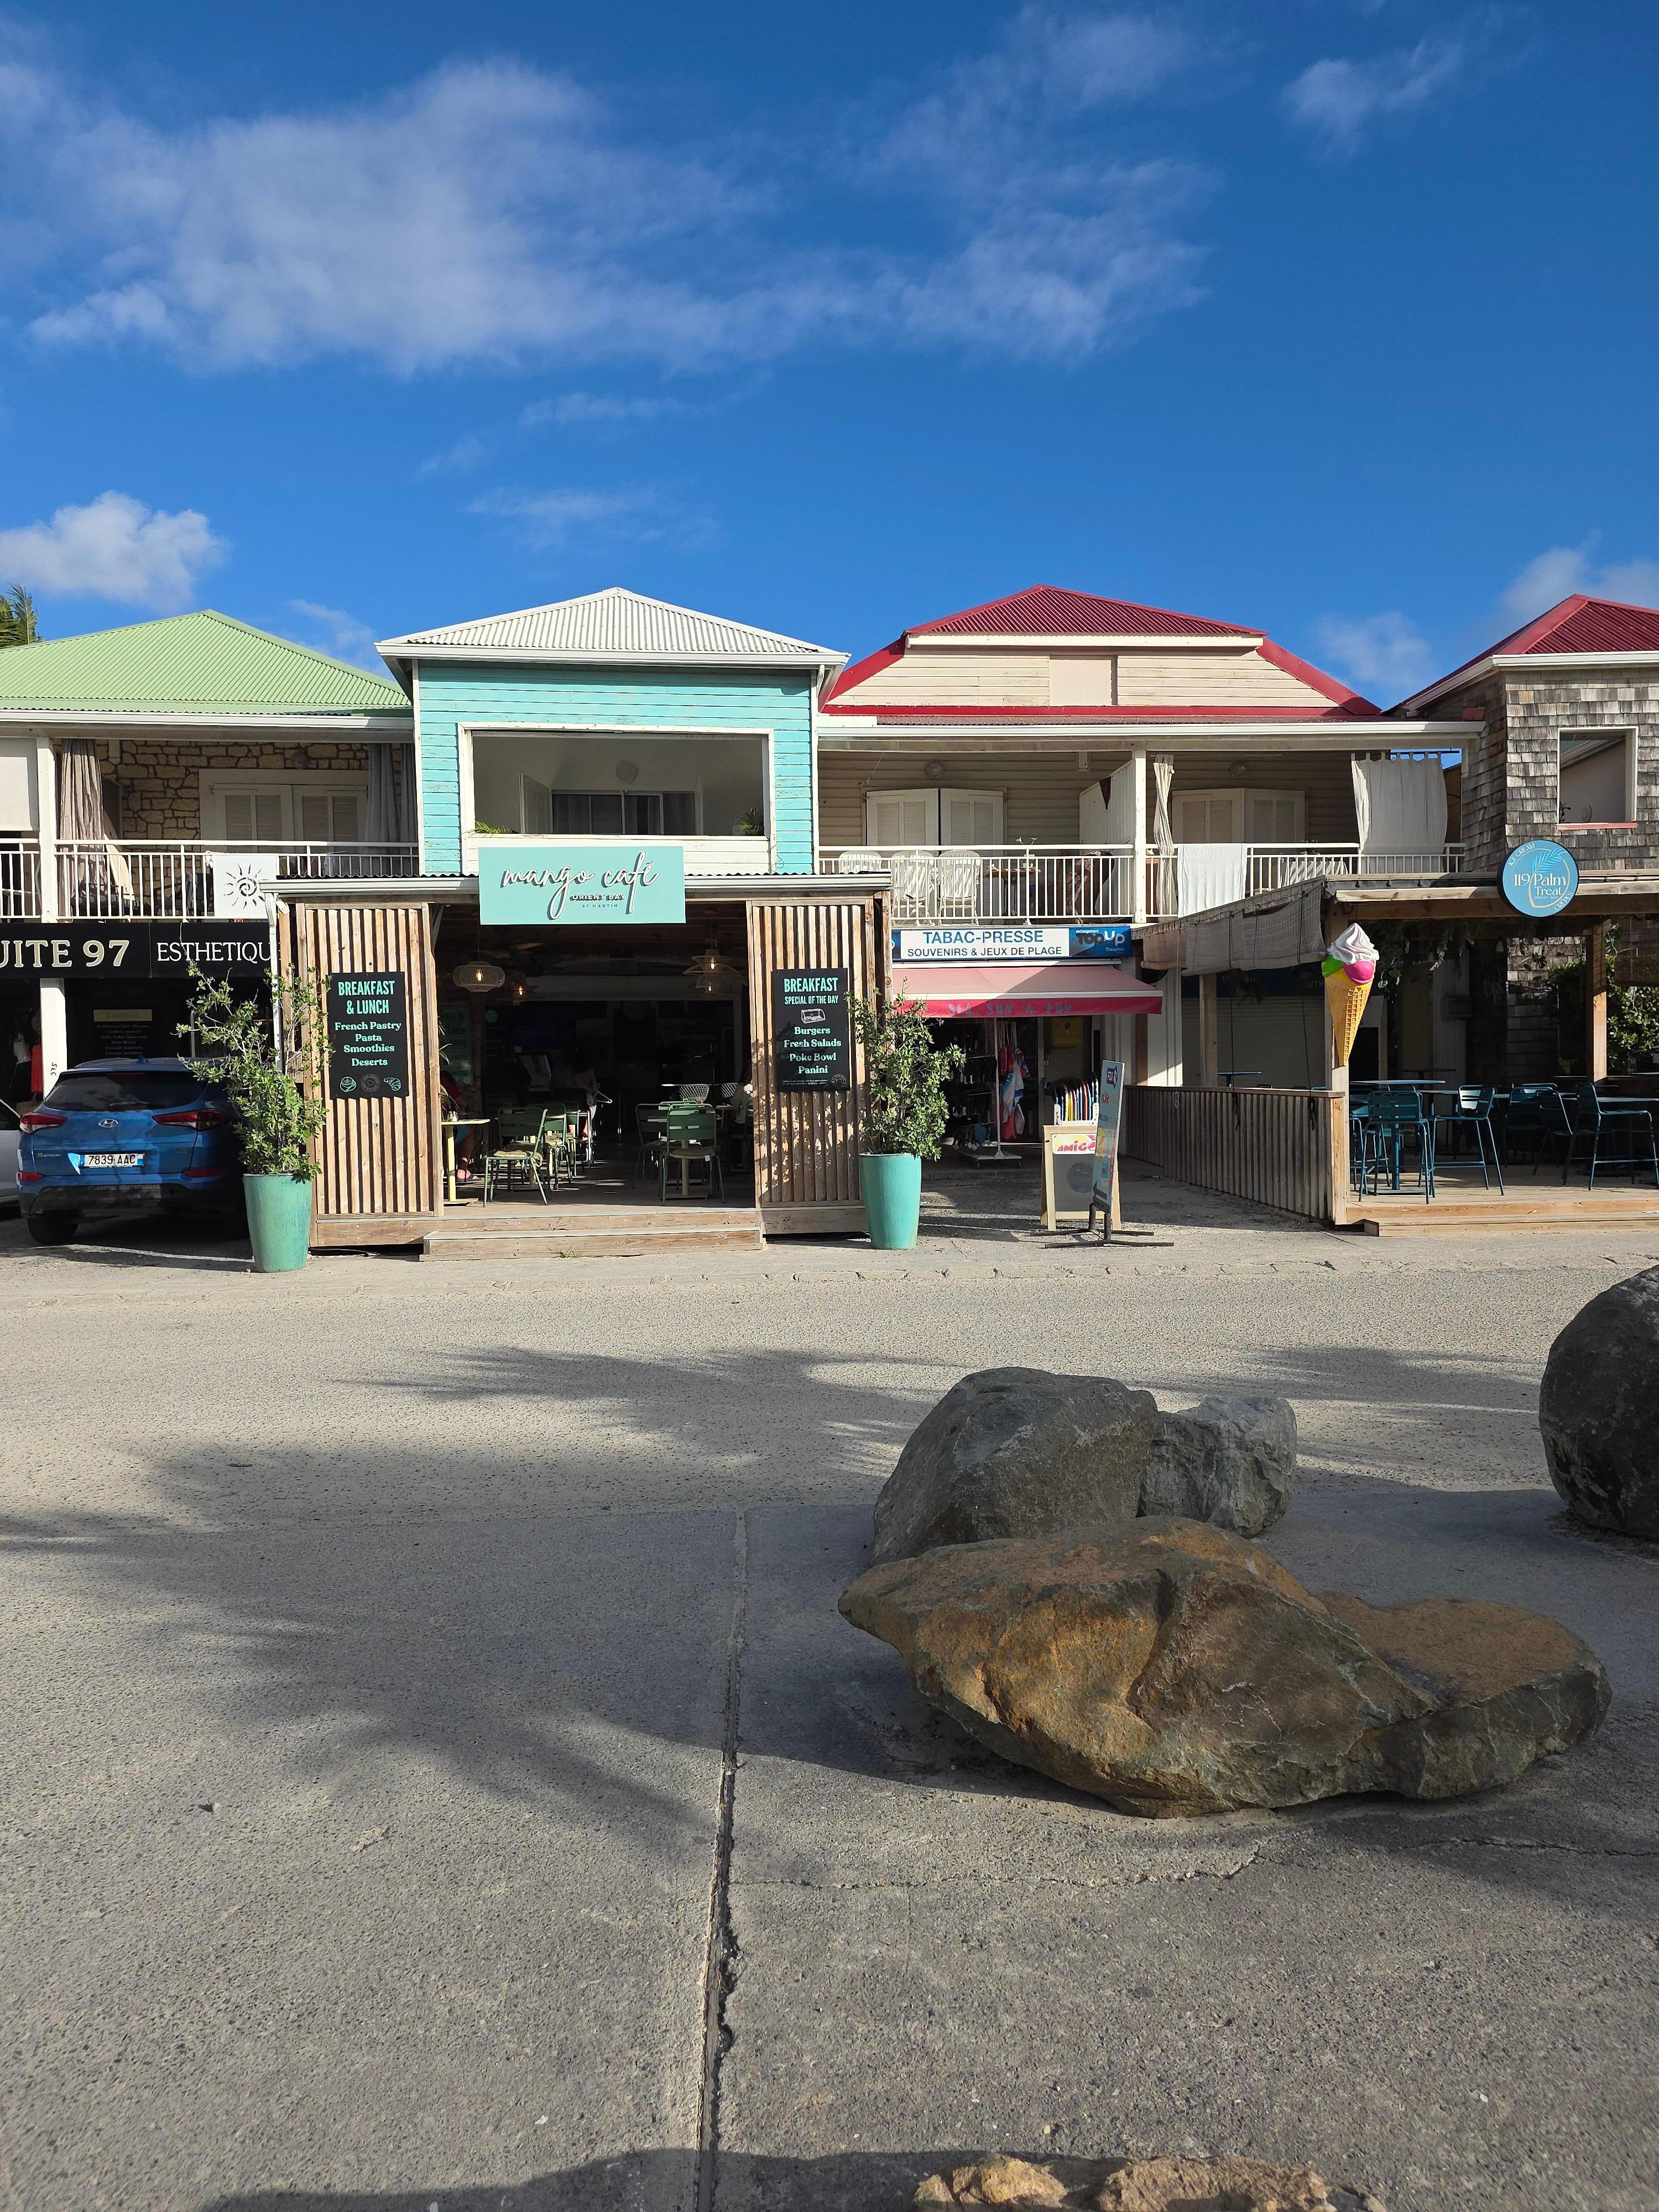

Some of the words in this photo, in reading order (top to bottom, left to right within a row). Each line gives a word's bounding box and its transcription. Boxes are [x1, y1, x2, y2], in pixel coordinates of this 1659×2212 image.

[501, 865, 596, 920] mango
[603, 850, 660, 914] café
[1514, 873, 1531, 886] 119
[1533, 873, 1566, 886] Palm
[1534, 886, 1562, 896] Treat
[923, 930, 1044, 944] TABAC-PRESSE
[82, 940, 130, 967] 97
[157, 942, 281, 964] ESTHETIQU
[907, 948, 968, 957] SOUVENIRS
[971, 948, 977, 956] &
[980, 947, 1007, 956] JEUX
[1028, 946, 1062, 955] PLAGE
[338, 980, 395, 996] BREAKFAST
[784, 977, 838, 992] BREAKFAST
[784, 995, 807, 1005] SPECIAL
[808, 995, 815, 1004] OF
[816, 995, 827, 1004] THE
[827, 995, 839, 1004] DAY
[346, 1000, 354, 1015] &
[357, 999, 389, 1014] LUNCH
[948, 1003, 973, 1015] SEA
[987, 1003, 1012, 1015] SUN
[1026, 1002, 1034, 1014] &
[1047, 1001, 1072, 1014] FUN
[335, 1021, 368, 1031] French
[369, 1021, 402, 1032] Pastry
[794, 1026, 831, 1036] Burgers
[355, 1034, 383, 1042] Pasta
[784, 1039, 810, 1048] Fresh
[811, 1038, 842, 1047] Salads
[343, 1043, 395, 1053] Smoothies
[351, 1058, 388, 1067] Deserts
[790, 1053, 812, 1062] Poke
[813, 1052, 837, 1061] Bowl
[798, 1065, 828, 1074] Panini
